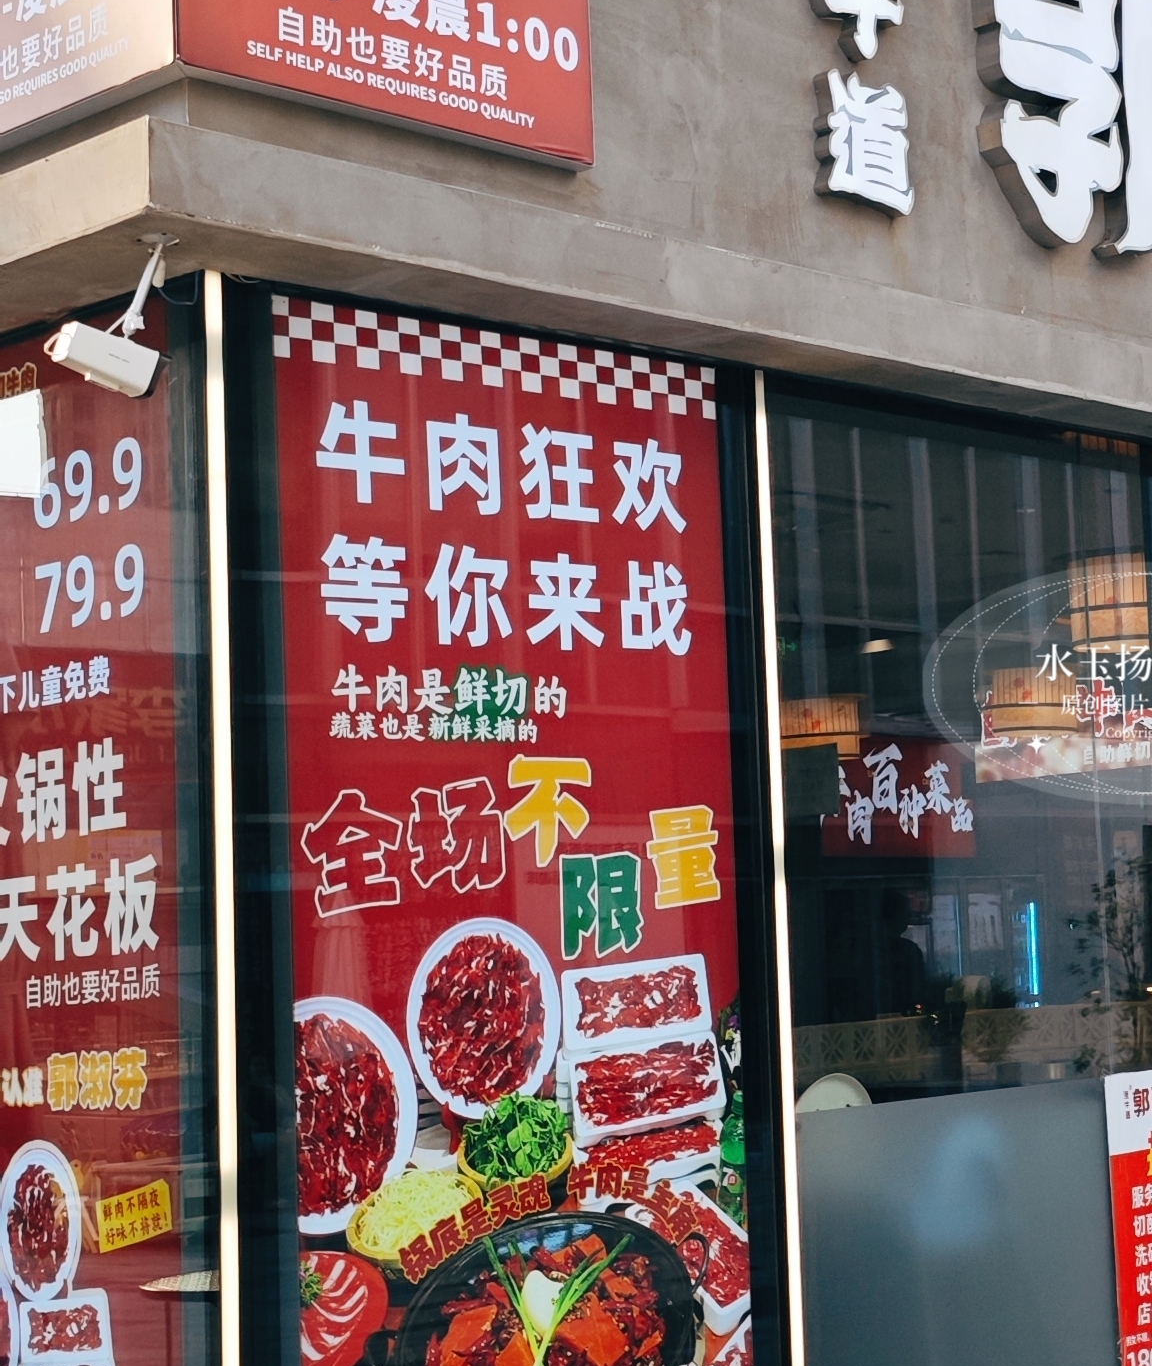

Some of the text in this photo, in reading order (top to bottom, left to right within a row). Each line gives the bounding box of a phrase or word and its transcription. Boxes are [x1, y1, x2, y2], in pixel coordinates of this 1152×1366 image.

[0, 1, 109, 81] 也要好品质
[13, 70, 58, 99] REQUIRES
[59, 55, 88, 79] GOOD
[89, 36, 130, 68] QUALITY
[246, 39, 535, 129] SELF HELP ALSO REQUIRES GOOD QUALITY
[277, 5, 508, 101] 自助也要好品质
[33, 436, 144, 529] 69.9
[315, 400, 687, 534] 牛肉狂欢
[34, 543, 145, 634] 79.9
[319, 533, 693, 657] 等你来战
[0, 655, 110, 715] 下儿童免费
[329, 711, 539, 745] 蔬菜也是新鲜采摘的
[330, 663, 568, 719] 牛肉是鲜切的
[0, 736, 127, 846] 锅性
[300, 754, 722, 961] 全场不限量
[0, 853, 160, 963] 天花板
[25, 963, 161, 1010] 自助也要好品质
[47, 1046, 148, 1112] 郭淑芬
[103, 1187, 161, 1222] 鲜肉不隔夜
[399, 1174, 552, 1285] 锅底是灵魂
[566, 1161, 700, 1246] 牛肉是主角
